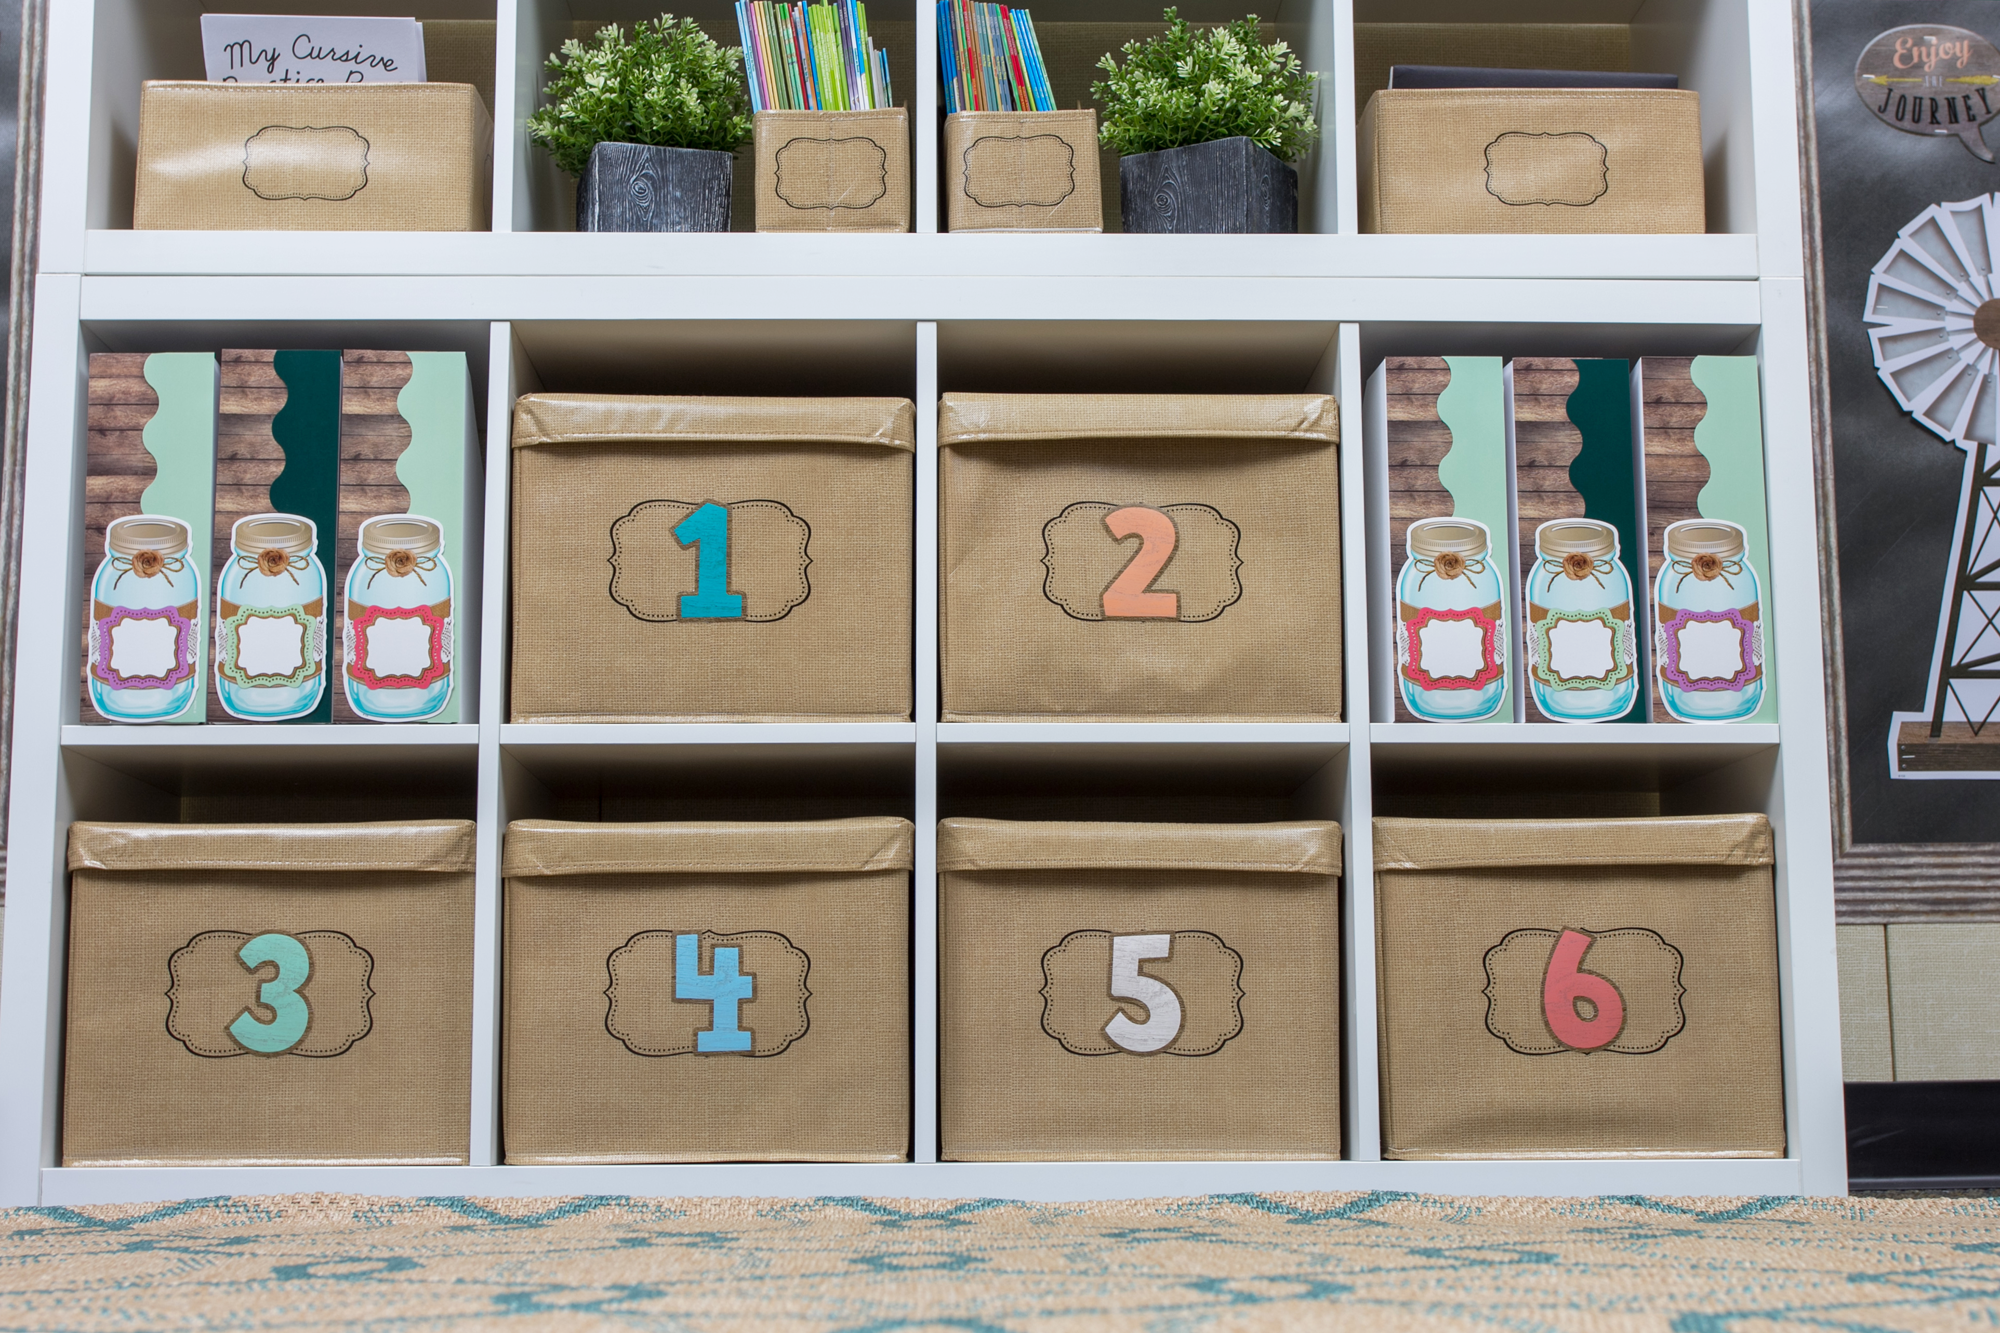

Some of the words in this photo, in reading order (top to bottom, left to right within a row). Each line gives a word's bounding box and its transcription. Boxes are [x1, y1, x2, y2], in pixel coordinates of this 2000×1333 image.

[223, 39, 281, 74] My
[292, 33, 398, 72] Cursive
[1877, 87, 1992, 125] JOURNEY
[1893, 36, 1974, 72] Enjoy
[671, 499, 746, 622] 1
[1101, 502, 1182, 621] 2
[224, 929, 314, 1055] 3
[671, 930, 757, 1055] 4
[1102, 932, 1185, 1055] 5
[1541, 926, 1627, 1052] 6
